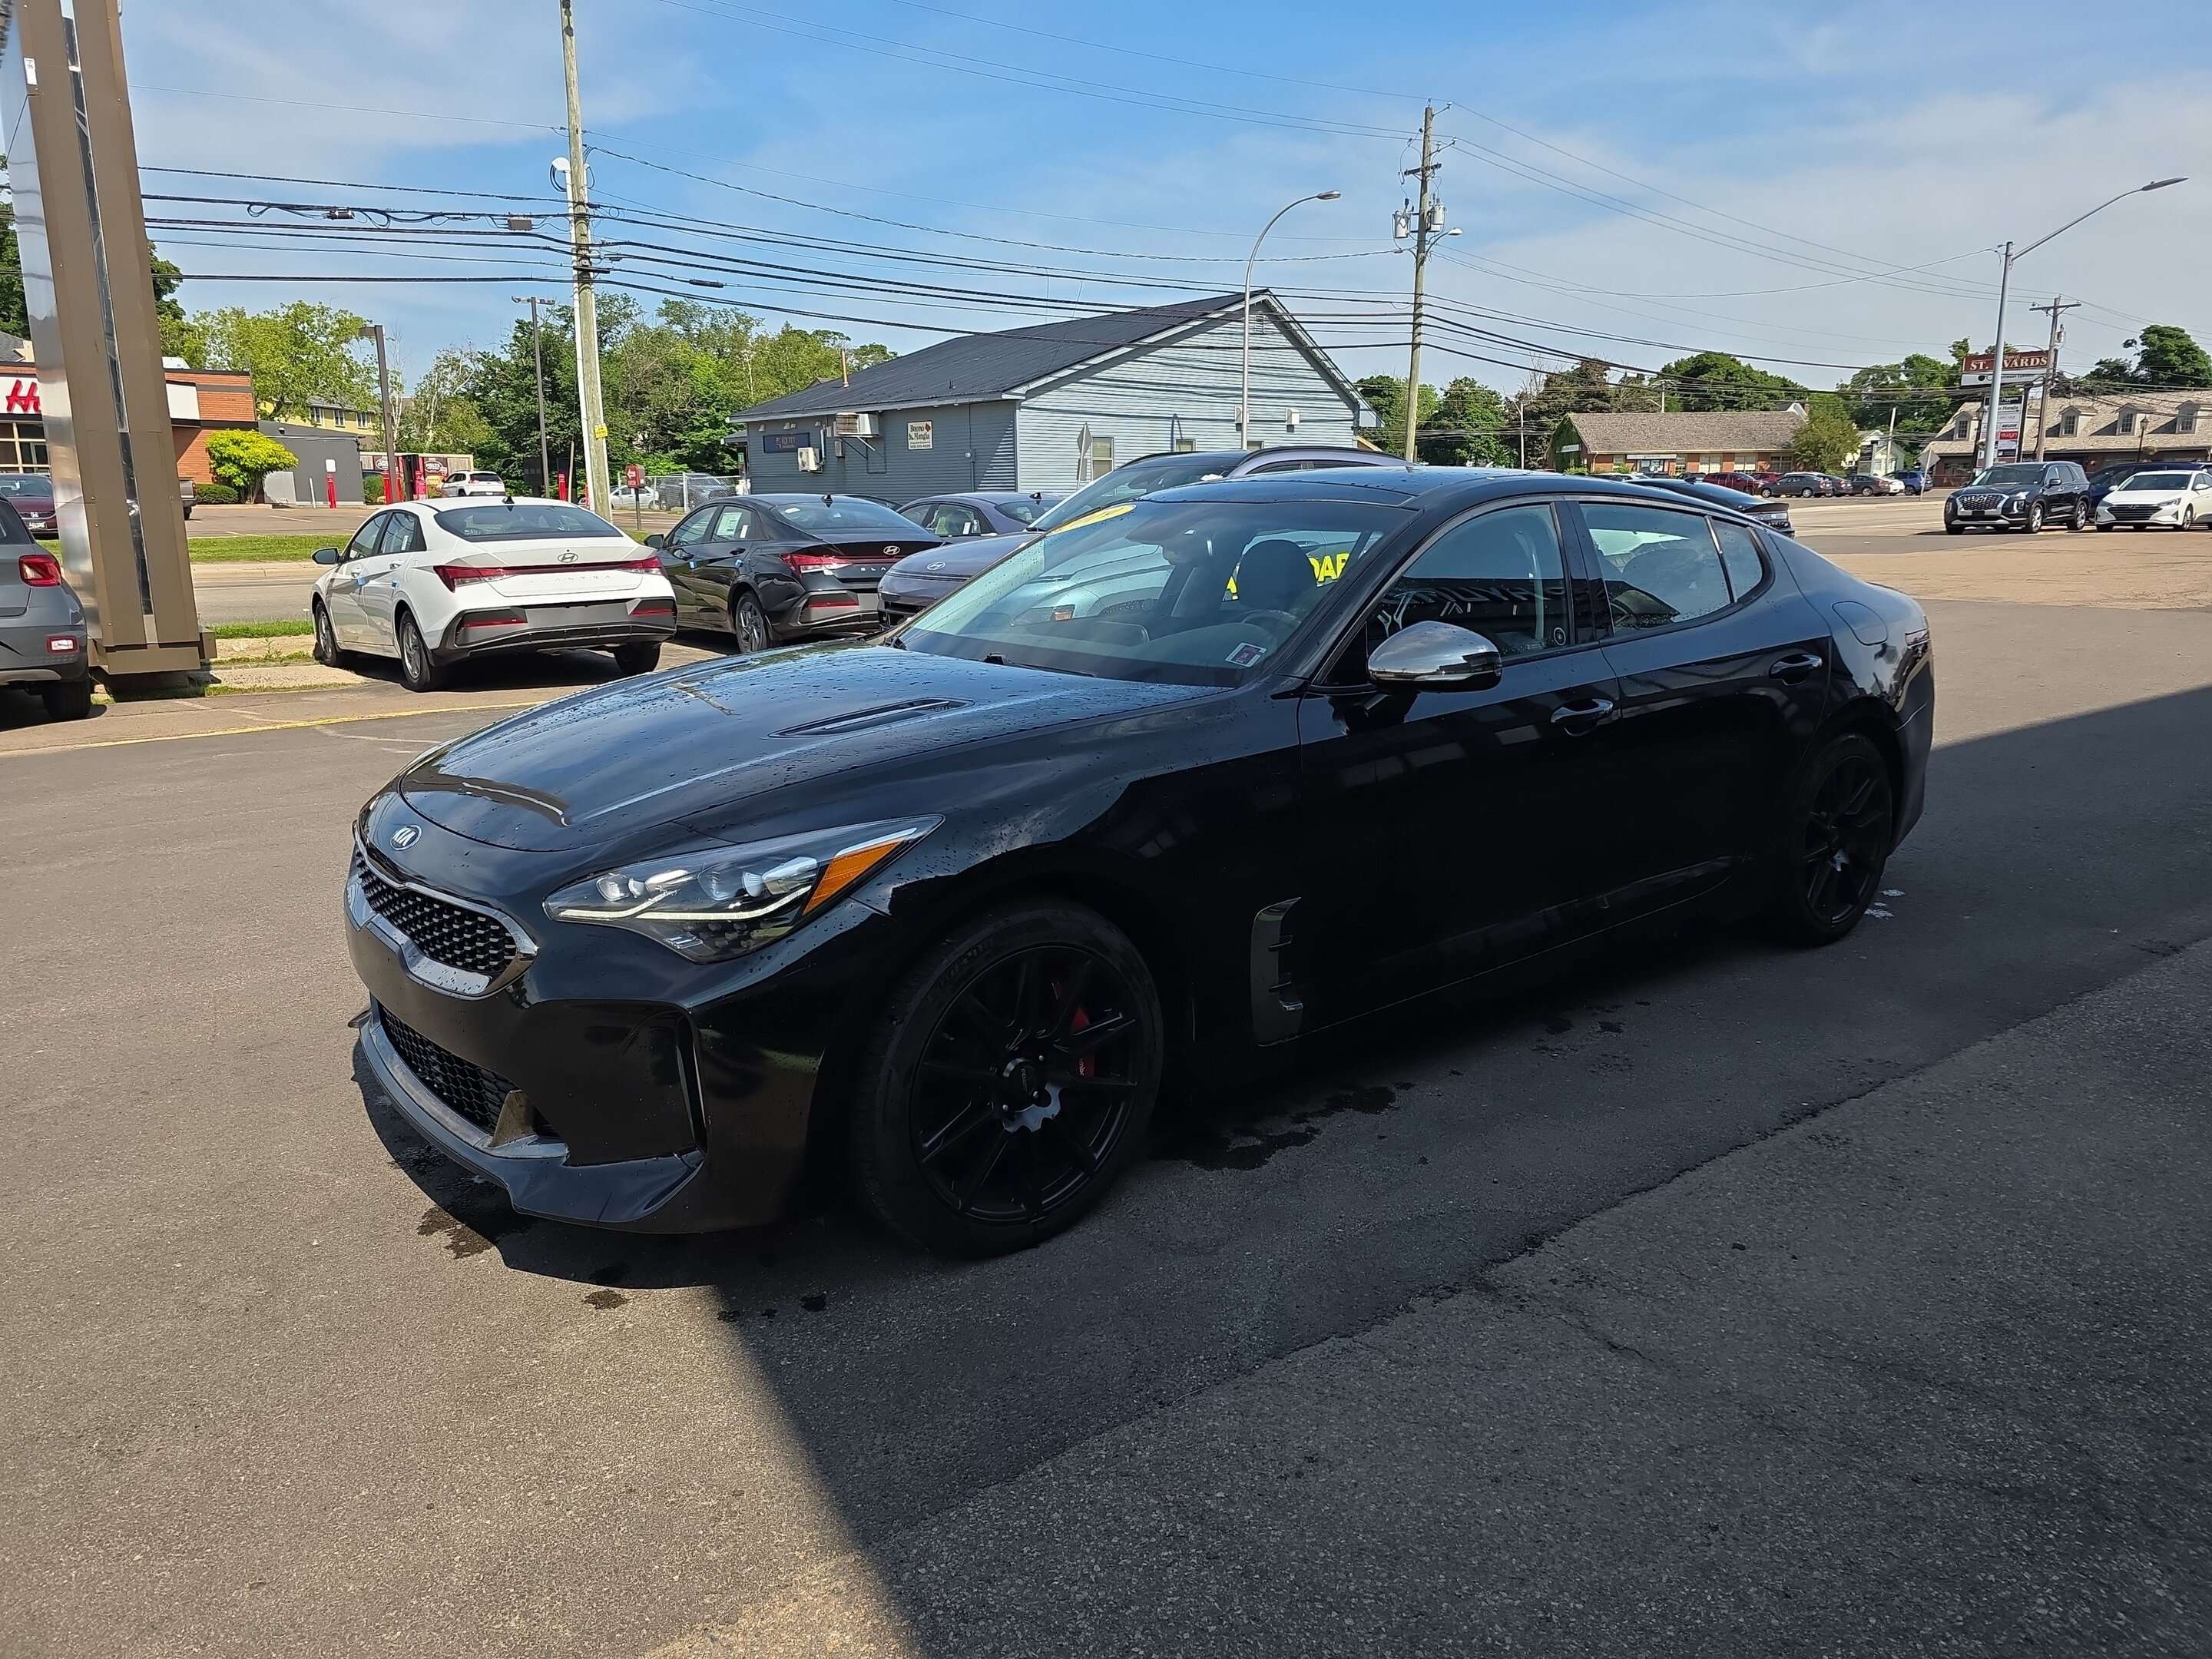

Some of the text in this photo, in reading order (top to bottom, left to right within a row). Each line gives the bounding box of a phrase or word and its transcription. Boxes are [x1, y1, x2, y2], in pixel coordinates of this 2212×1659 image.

[1970, 361, 1988, 370] ST.
[2003, 356, 2048, 368] VARDS
[392, 827, 416, 847] KIA
